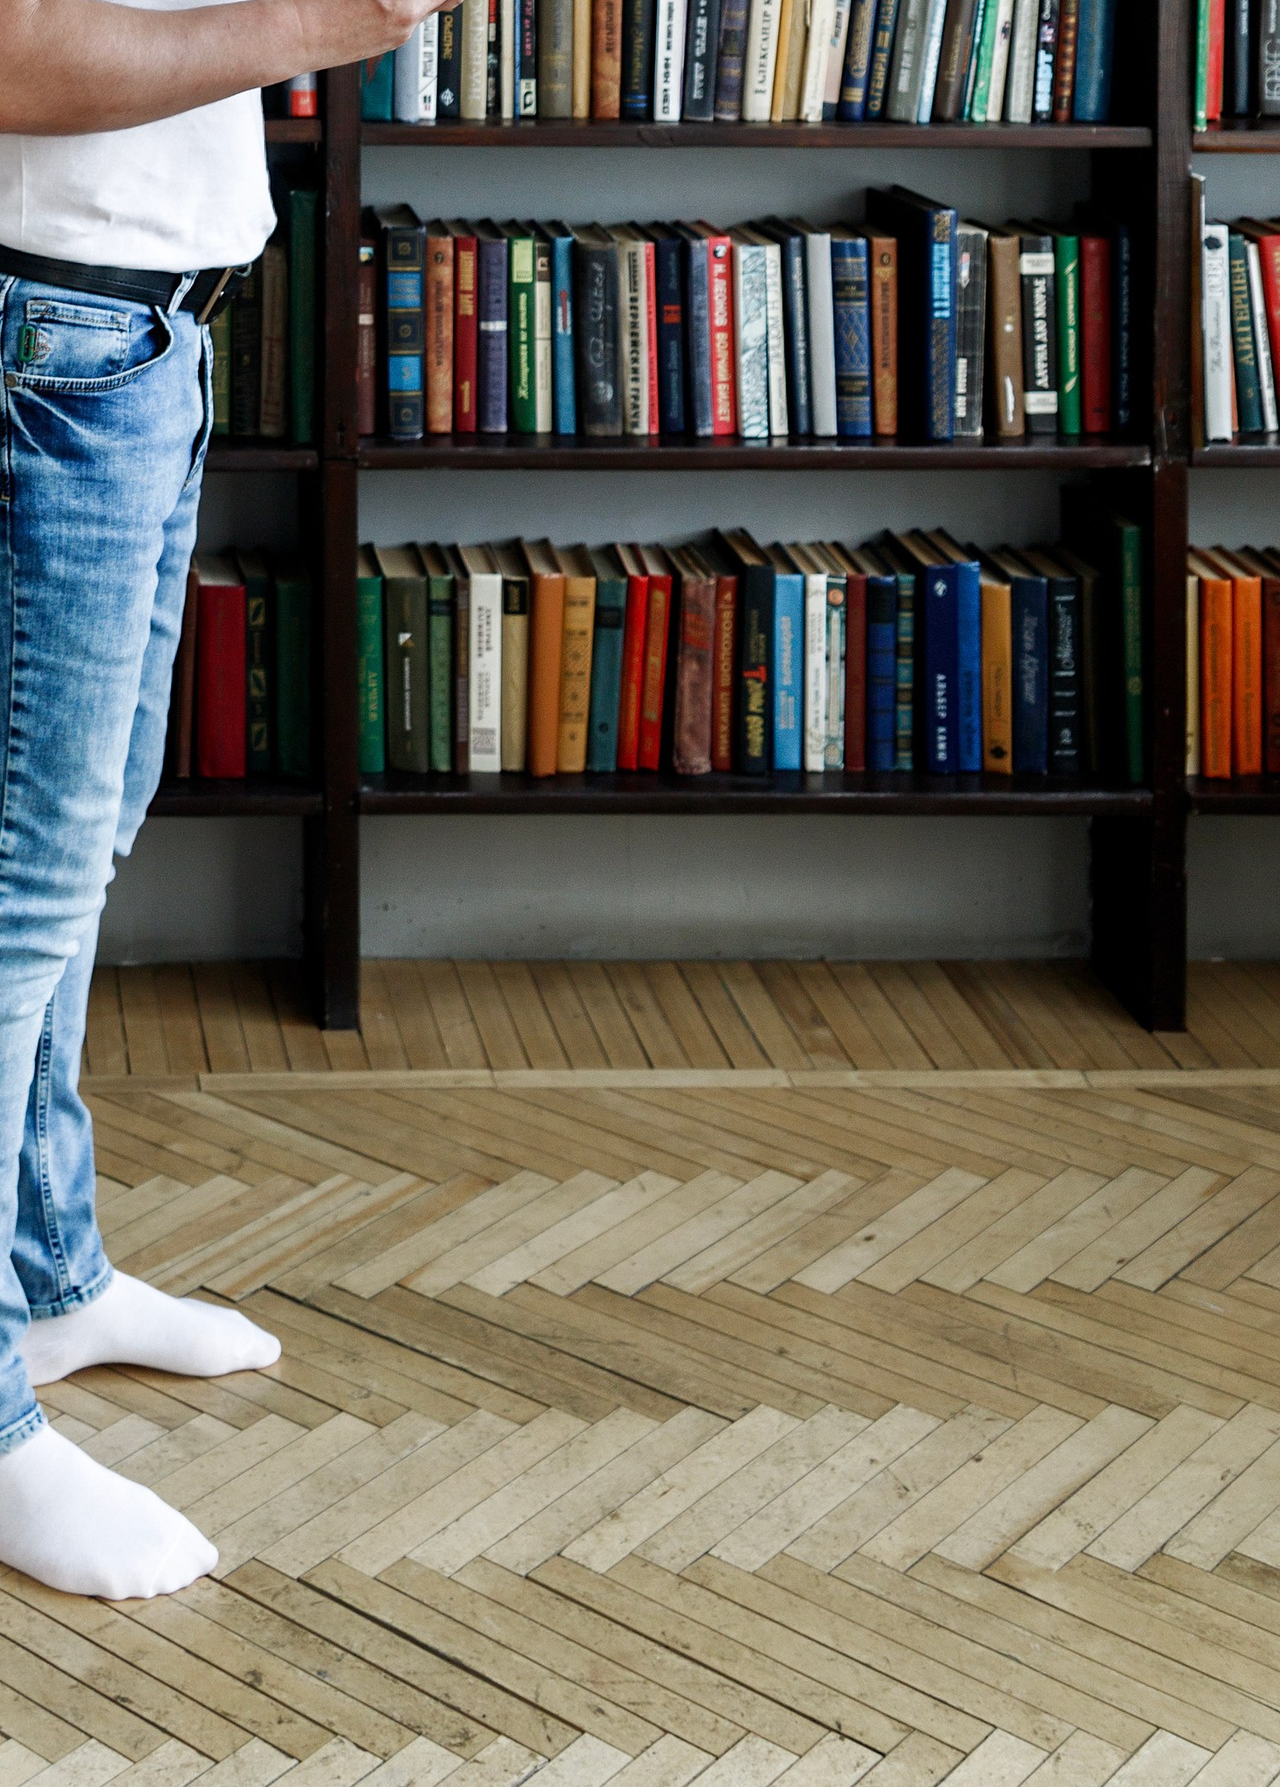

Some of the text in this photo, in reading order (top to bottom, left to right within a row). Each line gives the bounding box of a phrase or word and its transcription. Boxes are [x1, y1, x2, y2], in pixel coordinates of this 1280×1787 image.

[757, 9, 772, 86] АЛЕКСАНДР
[713, 278, 728, 327] ЛЕОНОВ
[717, 383, 731, 423] БИЛЕТ
